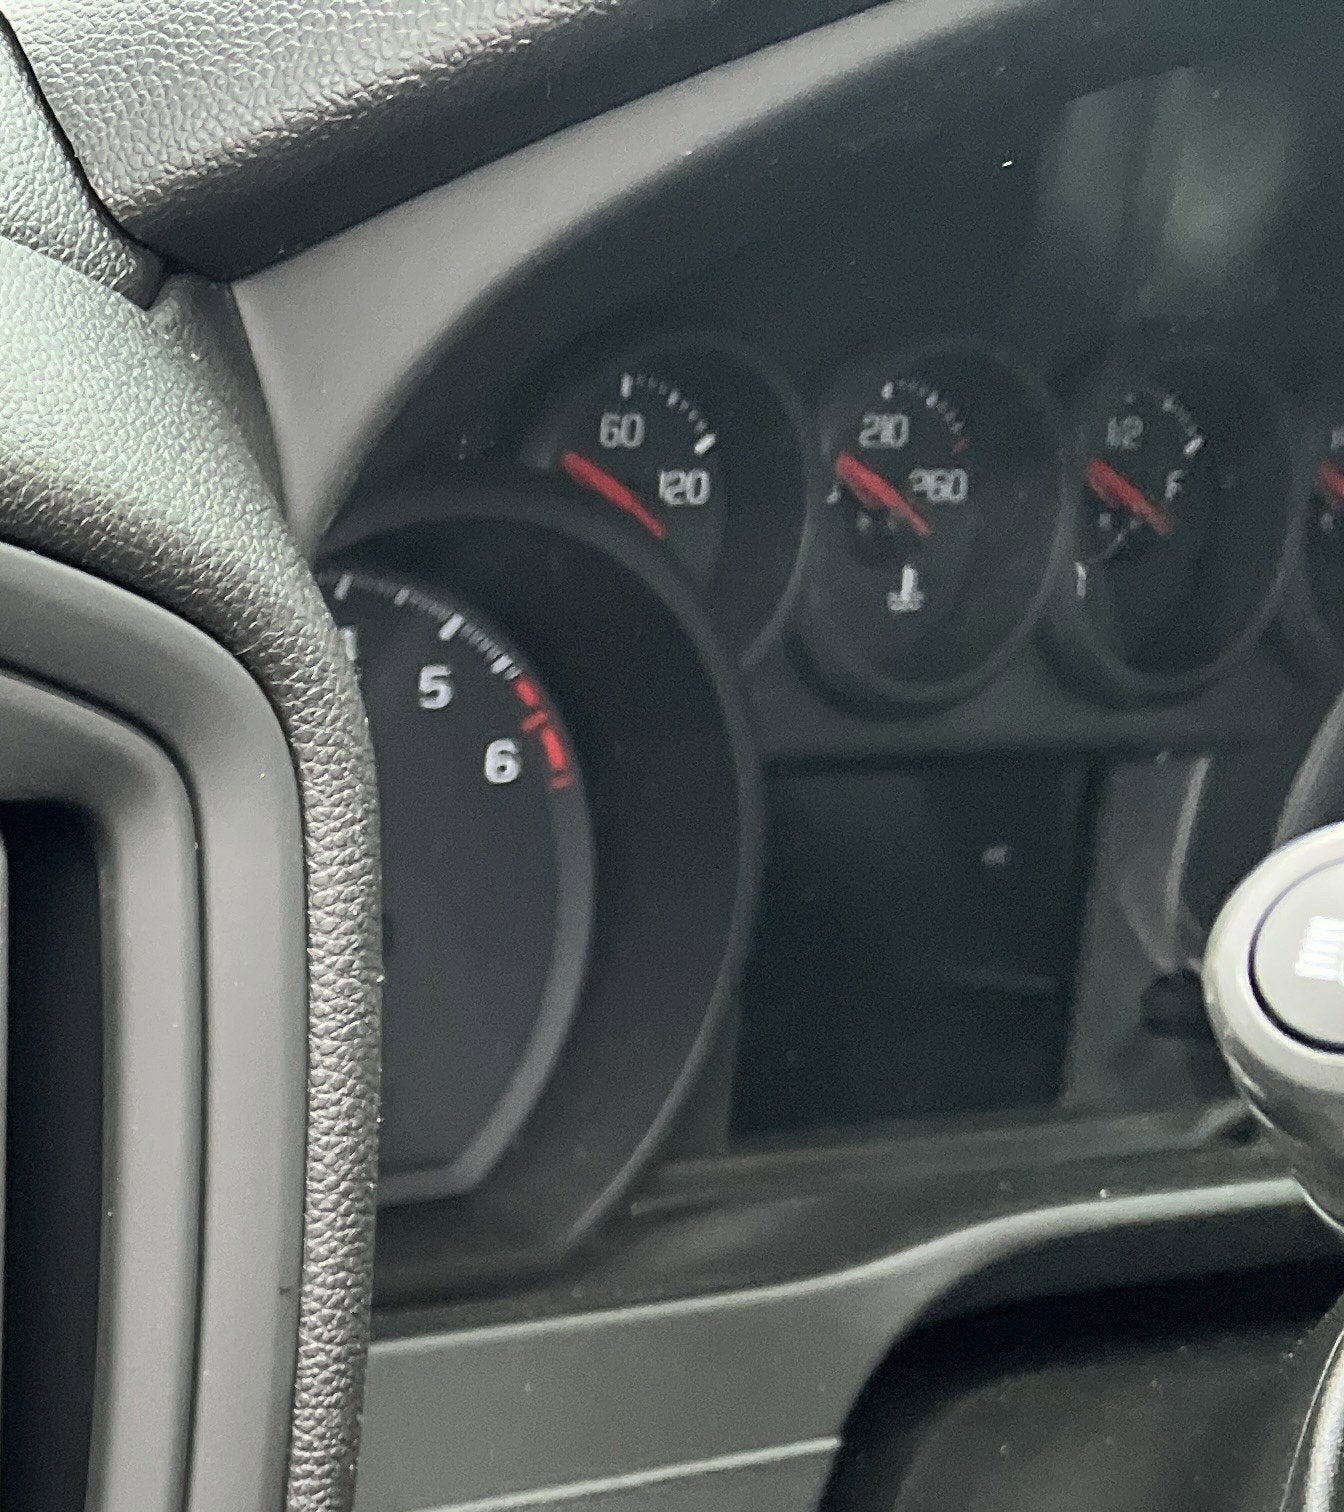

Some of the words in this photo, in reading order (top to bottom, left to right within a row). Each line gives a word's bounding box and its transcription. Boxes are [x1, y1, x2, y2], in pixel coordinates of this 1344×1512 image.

[600, 412, 645, 448] 60
[418, 664, 453, 710] 5
[484, 738, 521, 785] 6
